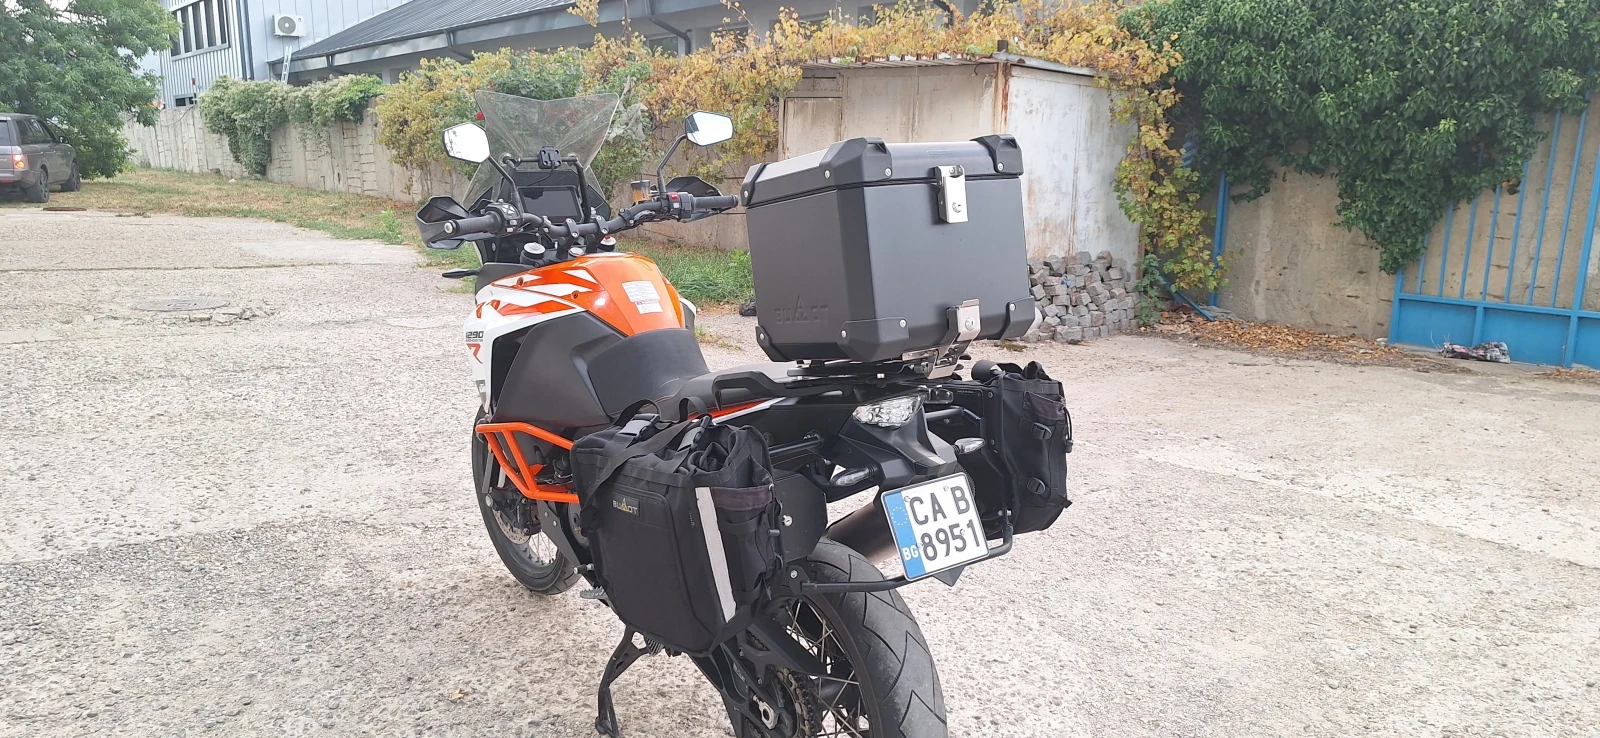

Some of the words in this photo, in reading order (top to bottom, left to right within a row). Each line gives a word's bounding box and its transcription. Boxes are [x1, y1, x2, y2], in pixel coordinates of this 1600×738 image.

[465, 330, 484, 339] 1290
[909, 492, 947, 526] CA
[950, 485, 971, 515] B
[901, 544, 919, 561] BG
[920, 519, 980, 561] 8951
